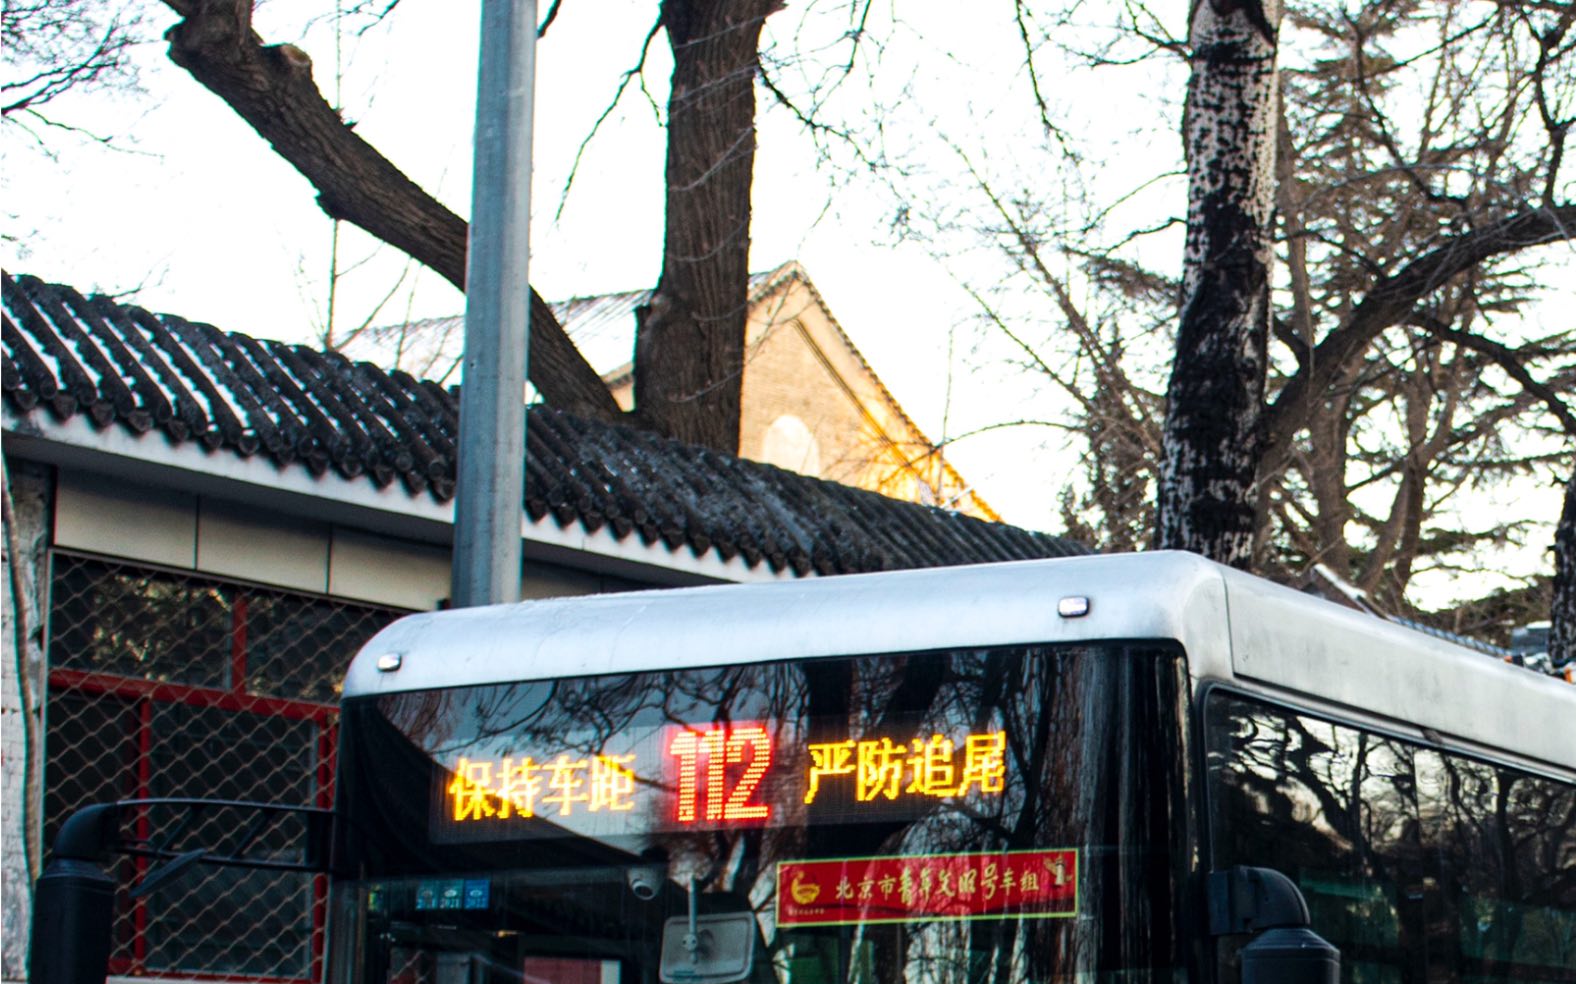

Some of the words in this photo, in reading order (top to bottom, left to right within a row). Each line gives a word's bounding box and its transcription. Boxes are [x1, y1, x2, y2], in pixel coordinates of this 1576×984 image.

[450, 755, 636, 821] 保持车距
[671, 727, 772, 822] 112
[804, 731, 1006, 803] 严防追尾
